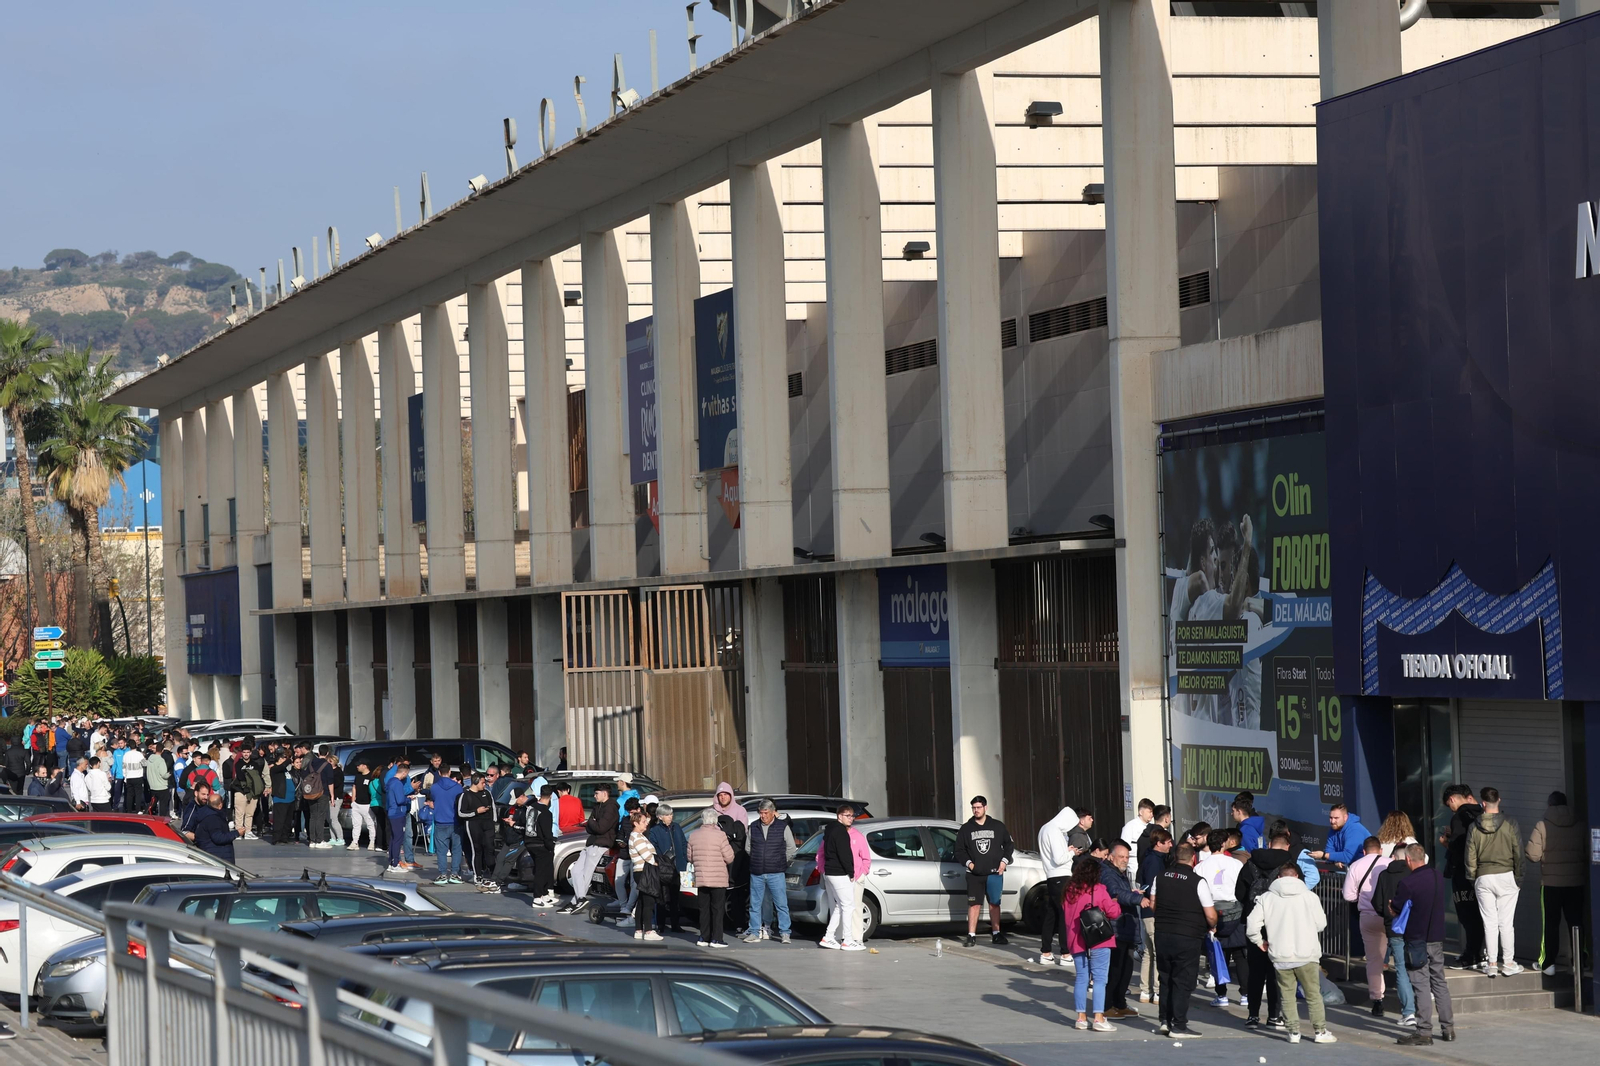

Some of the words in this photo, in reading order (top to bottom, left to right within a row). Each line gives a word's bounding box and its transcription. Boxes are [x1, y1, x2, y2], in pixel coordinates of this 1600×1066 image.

[1272, 472, 1312, 517] Olin
[1275, 604, 1292, 622] DEL
[1177, 626, 1190, 639] POR
[1191, 626, 1203, 639] SER
[1204, 626, 1246, 641] MALAGUISTA,
[1178, 651, 1186, 664] TE
[1187, 651, 1210, 664] DAMOS
[1211, 651, 1240, 664] NUESTRA
[1277, 667, 1291, 680] Fibra
[1292, 667, 1306, 680] Start
[1316, 668, 1331, 680] Todo
[1401, 654, 1452, 678] TIENDA
[1454, 654, 1510, 680] OFICIAL
[1179, 676, 1200, 688] MEJOR
[1201, 676, 1225, 689] OFERTA
[1277, 695, 1300, 740] 15
[1318, 696, 1341, 742] 19
[1199, 748, 1217, 787] POR
[1219, 750, 1263, 790] USTEDES!
[1280, 758, 1300, 770] 300Mb
[1324, 784, 1341, 796] 20GB
